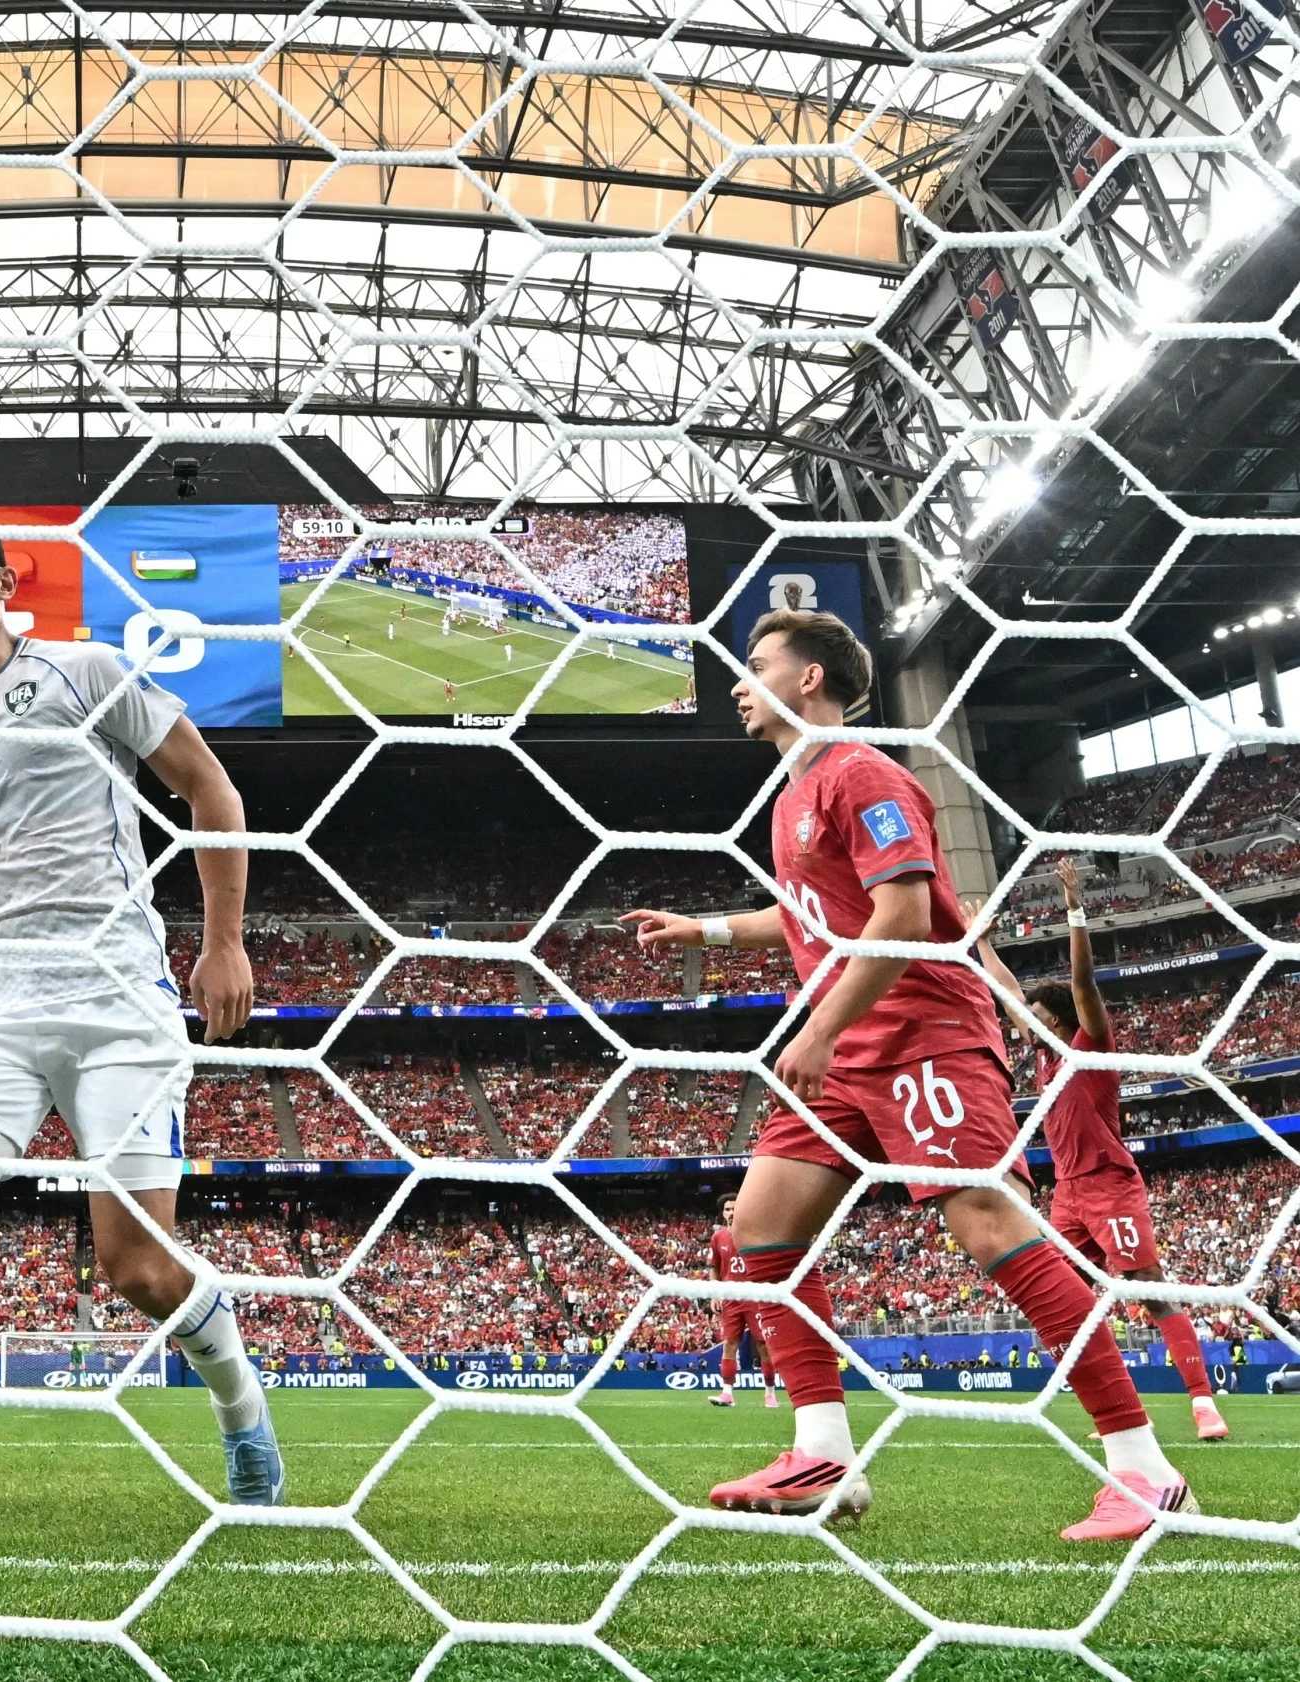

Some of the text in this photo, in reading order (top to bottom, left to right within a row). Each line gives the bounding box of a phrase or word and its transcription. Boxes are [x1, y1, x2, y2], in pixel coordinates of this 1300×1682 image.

[1234, 15, 1266, 52] 201
[1065, 122, 1095, 162] CHAMPIO
[1095, 177, 1122, 213] 2012
[988, 309, 1007, 338] 2011
[302, 522, 343, 534] 59:10
[9, 685, 33, 703] UFA
[1120, 952, 1218, 977] FIFA WORLD CUP 2026
[357, 1007, 401, 1016] HOUSTON
[1120, 1085, 1152, 1097] 2026
[892, 1060, 965, 1146] 26
[265, 1163, 321, 1172] HOUSTON
[701, 1157, 750, 1168] HOUSTO
[1108, 1217, 1140, 1249] 13
[730, 1256, 746, 1274] 23
[80, 1373, 162, 1386] HYUDAI
[285, 1373, 366, 1387] HYUNDAI
[493, 1373, 575, 1387] HYUNDAI
[891, 1373, 923, 1388] HYUNDAI
[973, 1372, 1012, 1388] HYUNDAI
